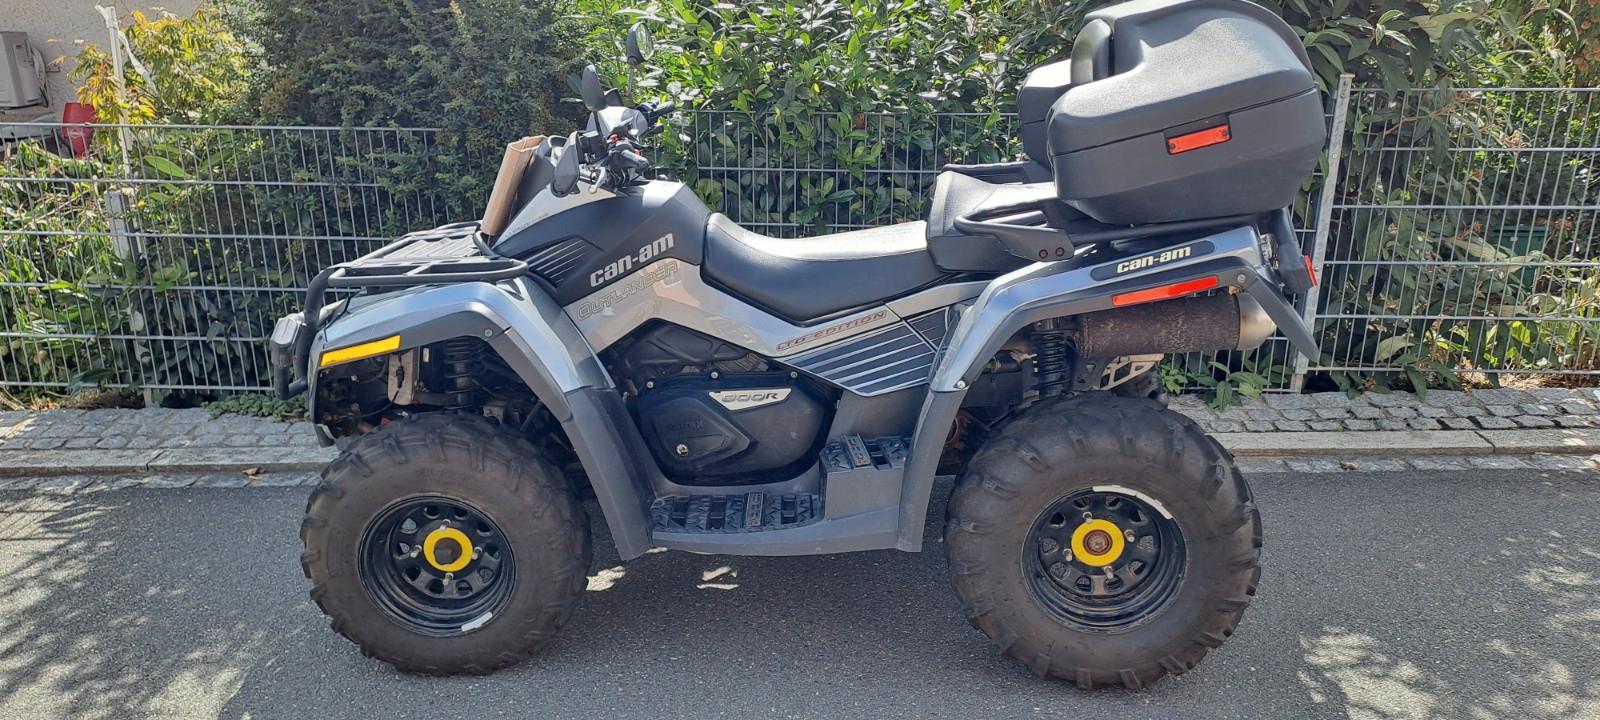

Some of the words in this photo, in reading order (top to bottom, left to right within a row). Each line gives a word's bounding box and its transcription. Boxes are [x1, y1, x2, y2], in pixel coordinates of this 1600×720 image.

[590, 232, 675, 287] can-am
[1117, 246, 1191, 273] can-am
[578, 260, 679, 320] OUTLANDER
[813, 310, 888, 338] EDITION
